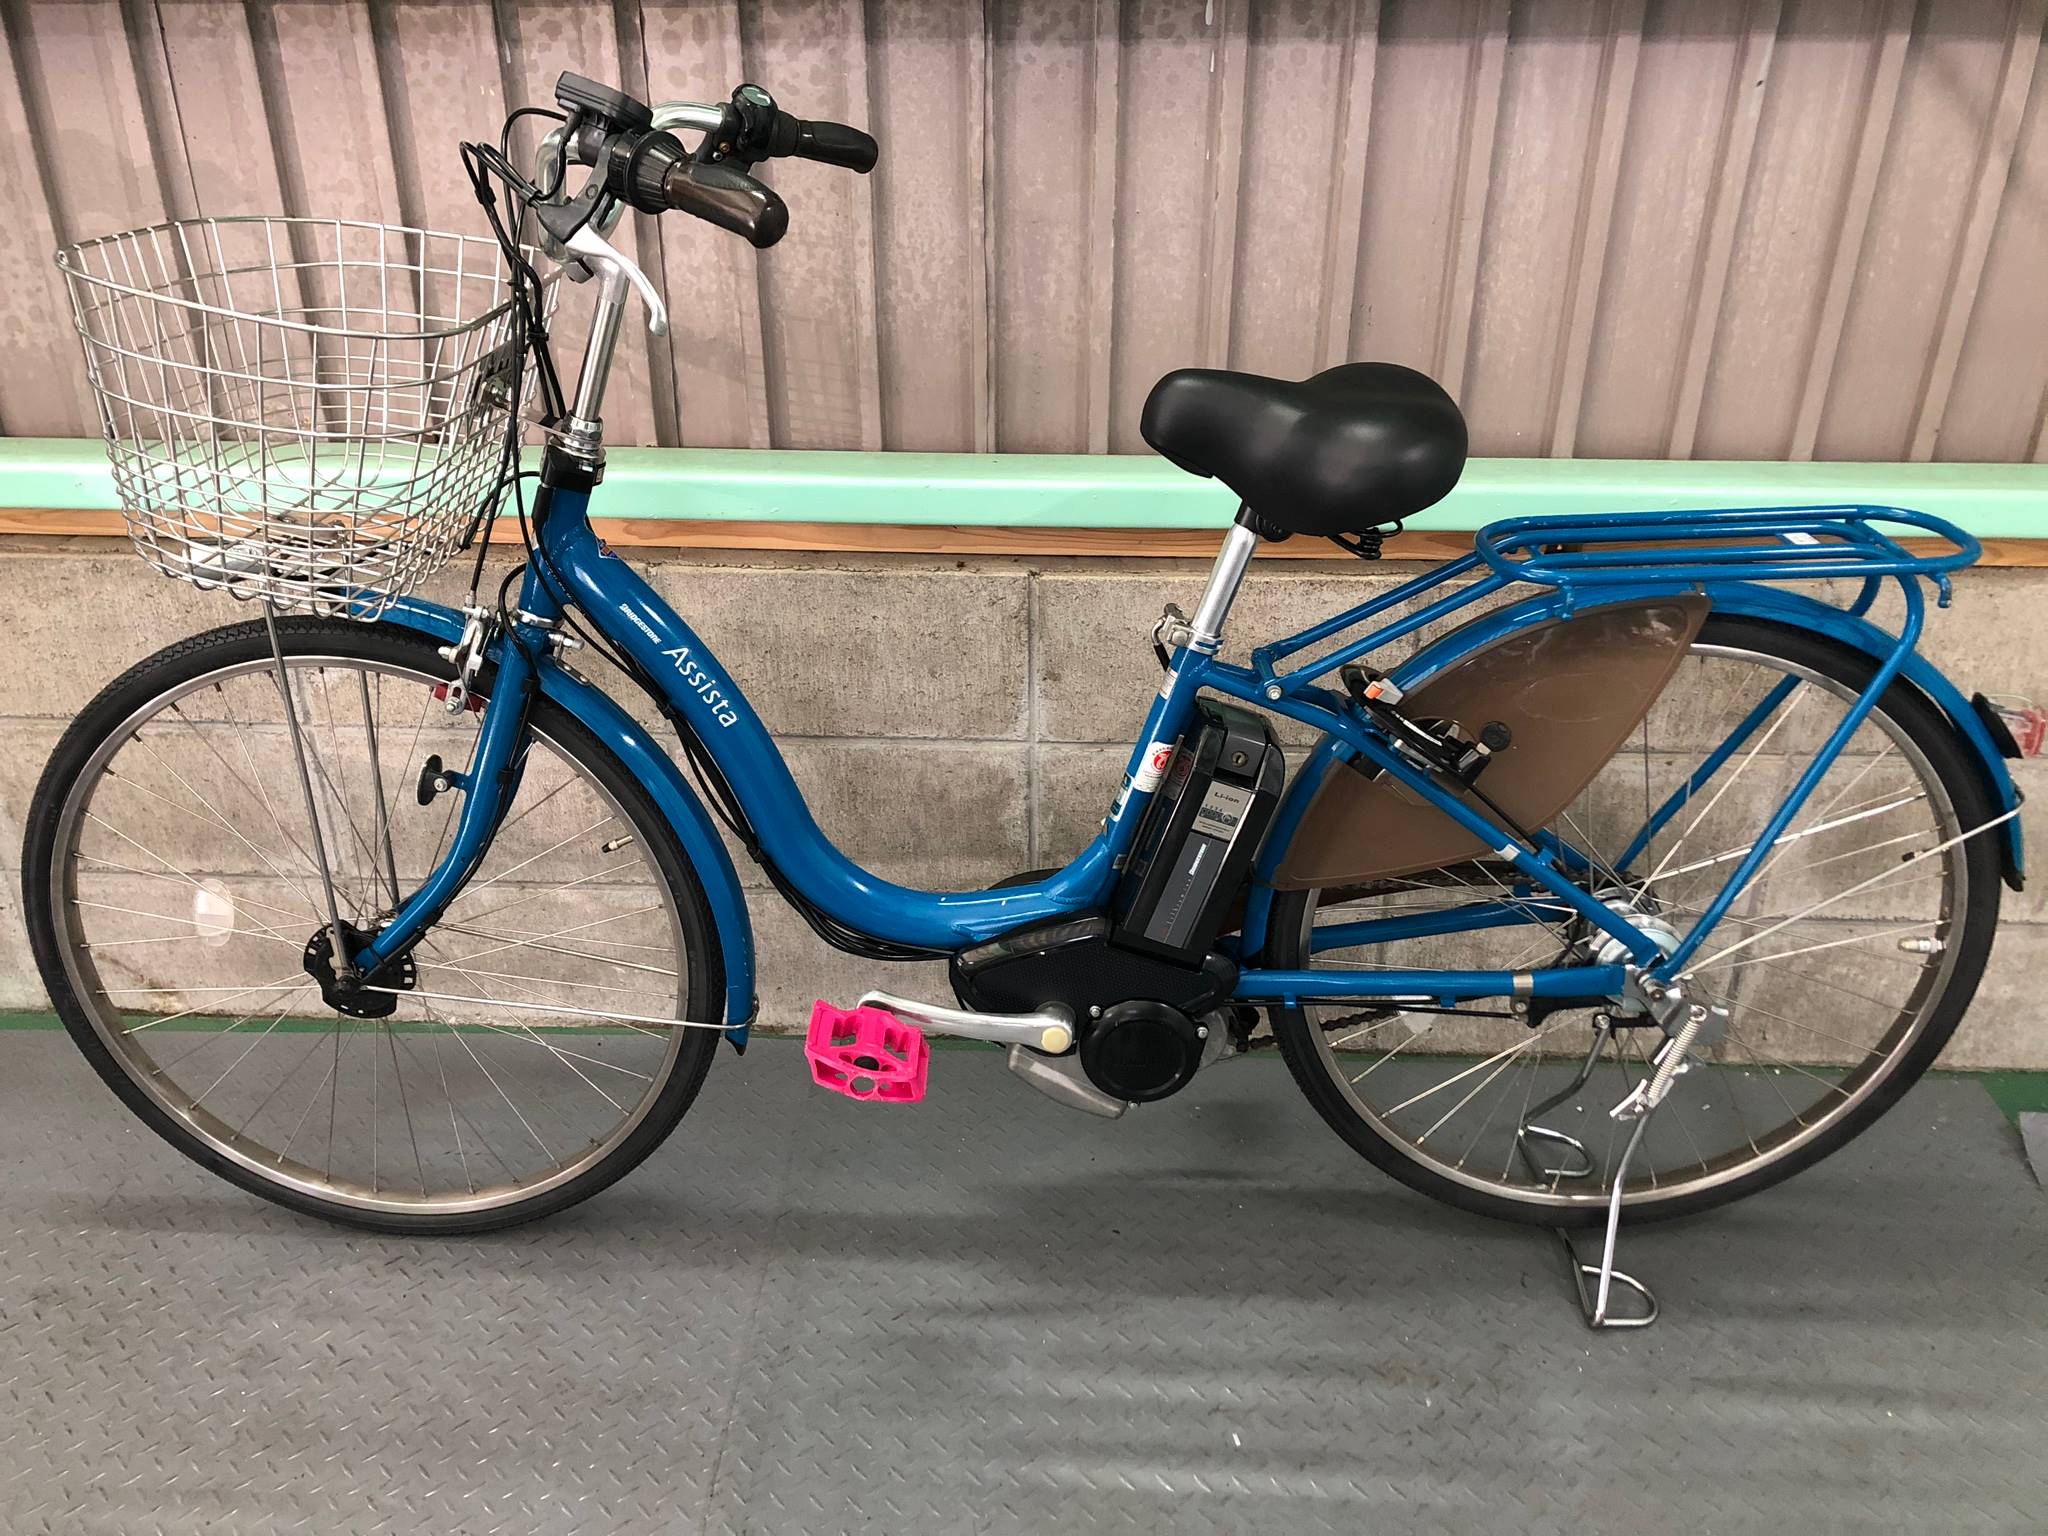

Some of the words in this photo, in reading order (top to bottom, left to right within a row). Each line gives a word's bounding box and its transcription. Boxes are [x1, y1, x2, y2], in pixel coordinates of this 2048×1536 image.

[618, 603, 662, 645] BRIDGESTONE
[661, 646, 738, 728] Assista
[1214, 791, 1240, 804] Li-ion
